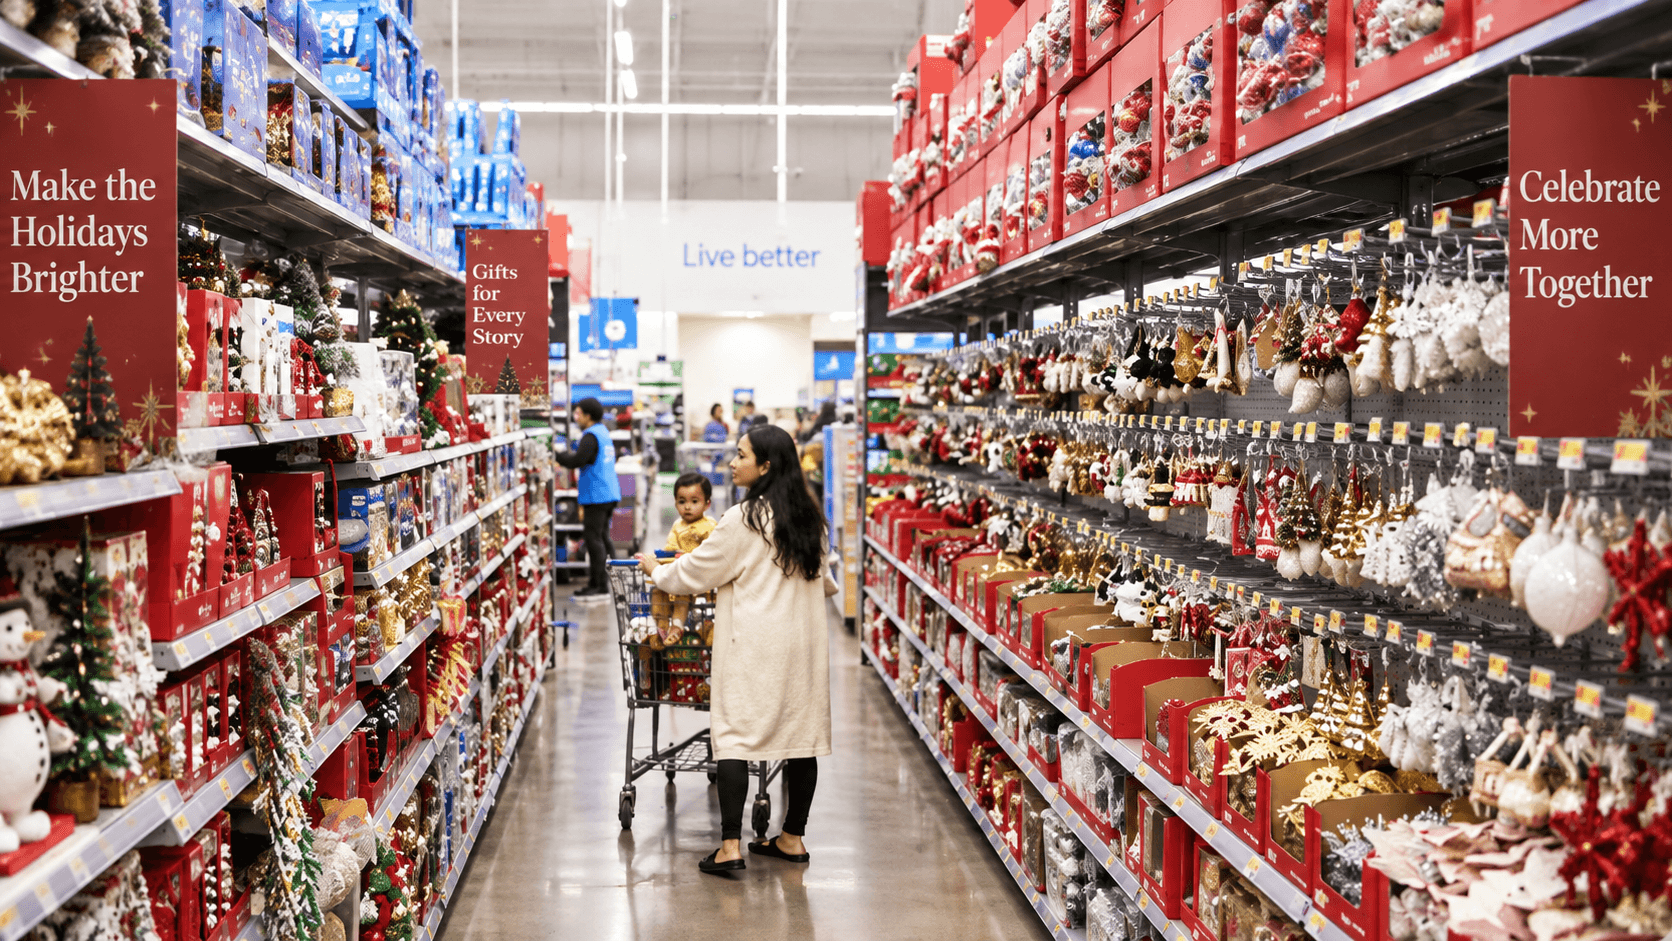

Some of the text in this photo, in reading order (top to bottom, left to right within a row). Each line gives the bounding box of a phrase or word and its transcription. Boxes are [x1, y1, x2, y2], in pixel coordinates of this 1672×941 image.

[10, 168, 156, 201] Make the
[1519, 168, 1661, 204] Celebrate
[10, 214, 148, 257] Holidays
[1519, 219, 1599, 251] More
[472, 263, 518, 280] Gifts
[684, 243, 820, 268] Live better
[10, 260, 144, 303] Brighter
[472, 284, 501, 301] for
[1519, 264, 1653, 309] Together
[472, 306, 527, 327] Every
[472, 327, 524, 349] Story
